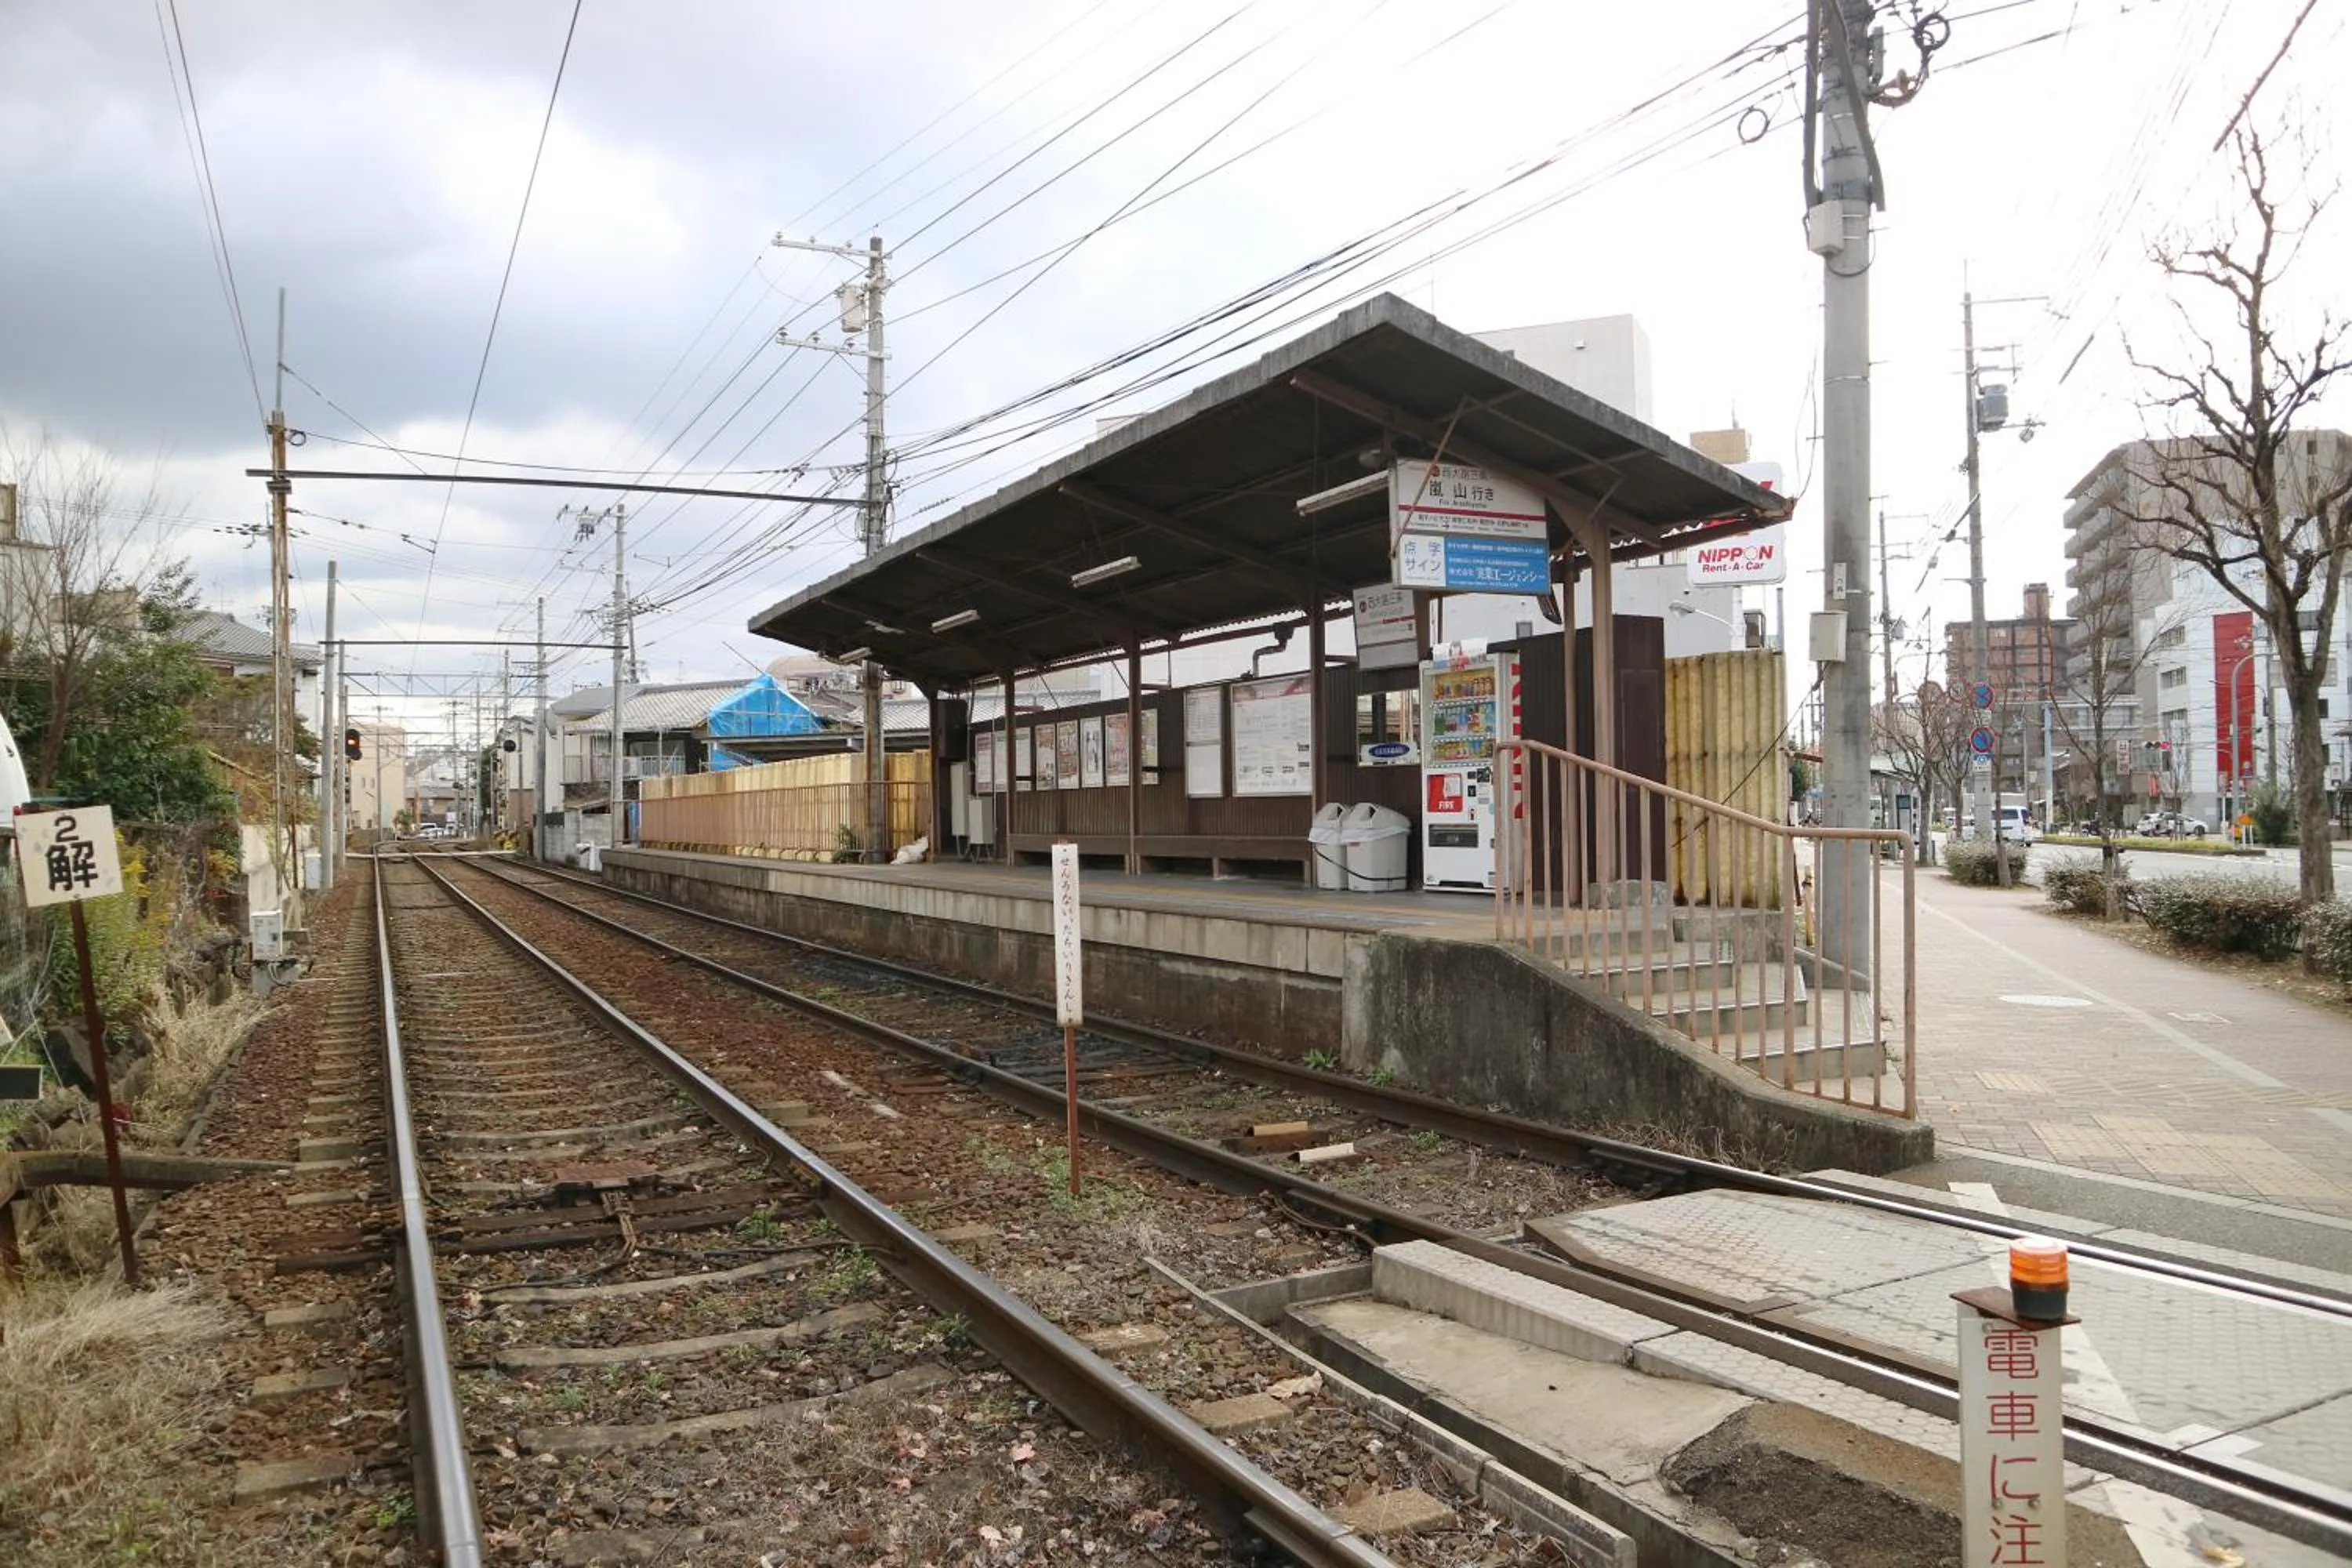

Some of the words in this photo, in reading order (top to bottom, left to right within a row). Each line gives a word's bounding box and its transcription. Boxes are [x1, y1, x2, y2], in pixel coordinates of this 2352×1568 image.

[1429, 481, 1494, 502] 嵐山行き
[1405, 559, 1441, 572] サイン
[1697, 545, 1774, 564] NIPPON
[54, 815, 79, 842] 2
[45, 840, 99, 891] 解
[1984, 1329, 2045, 1566] 電車に注
